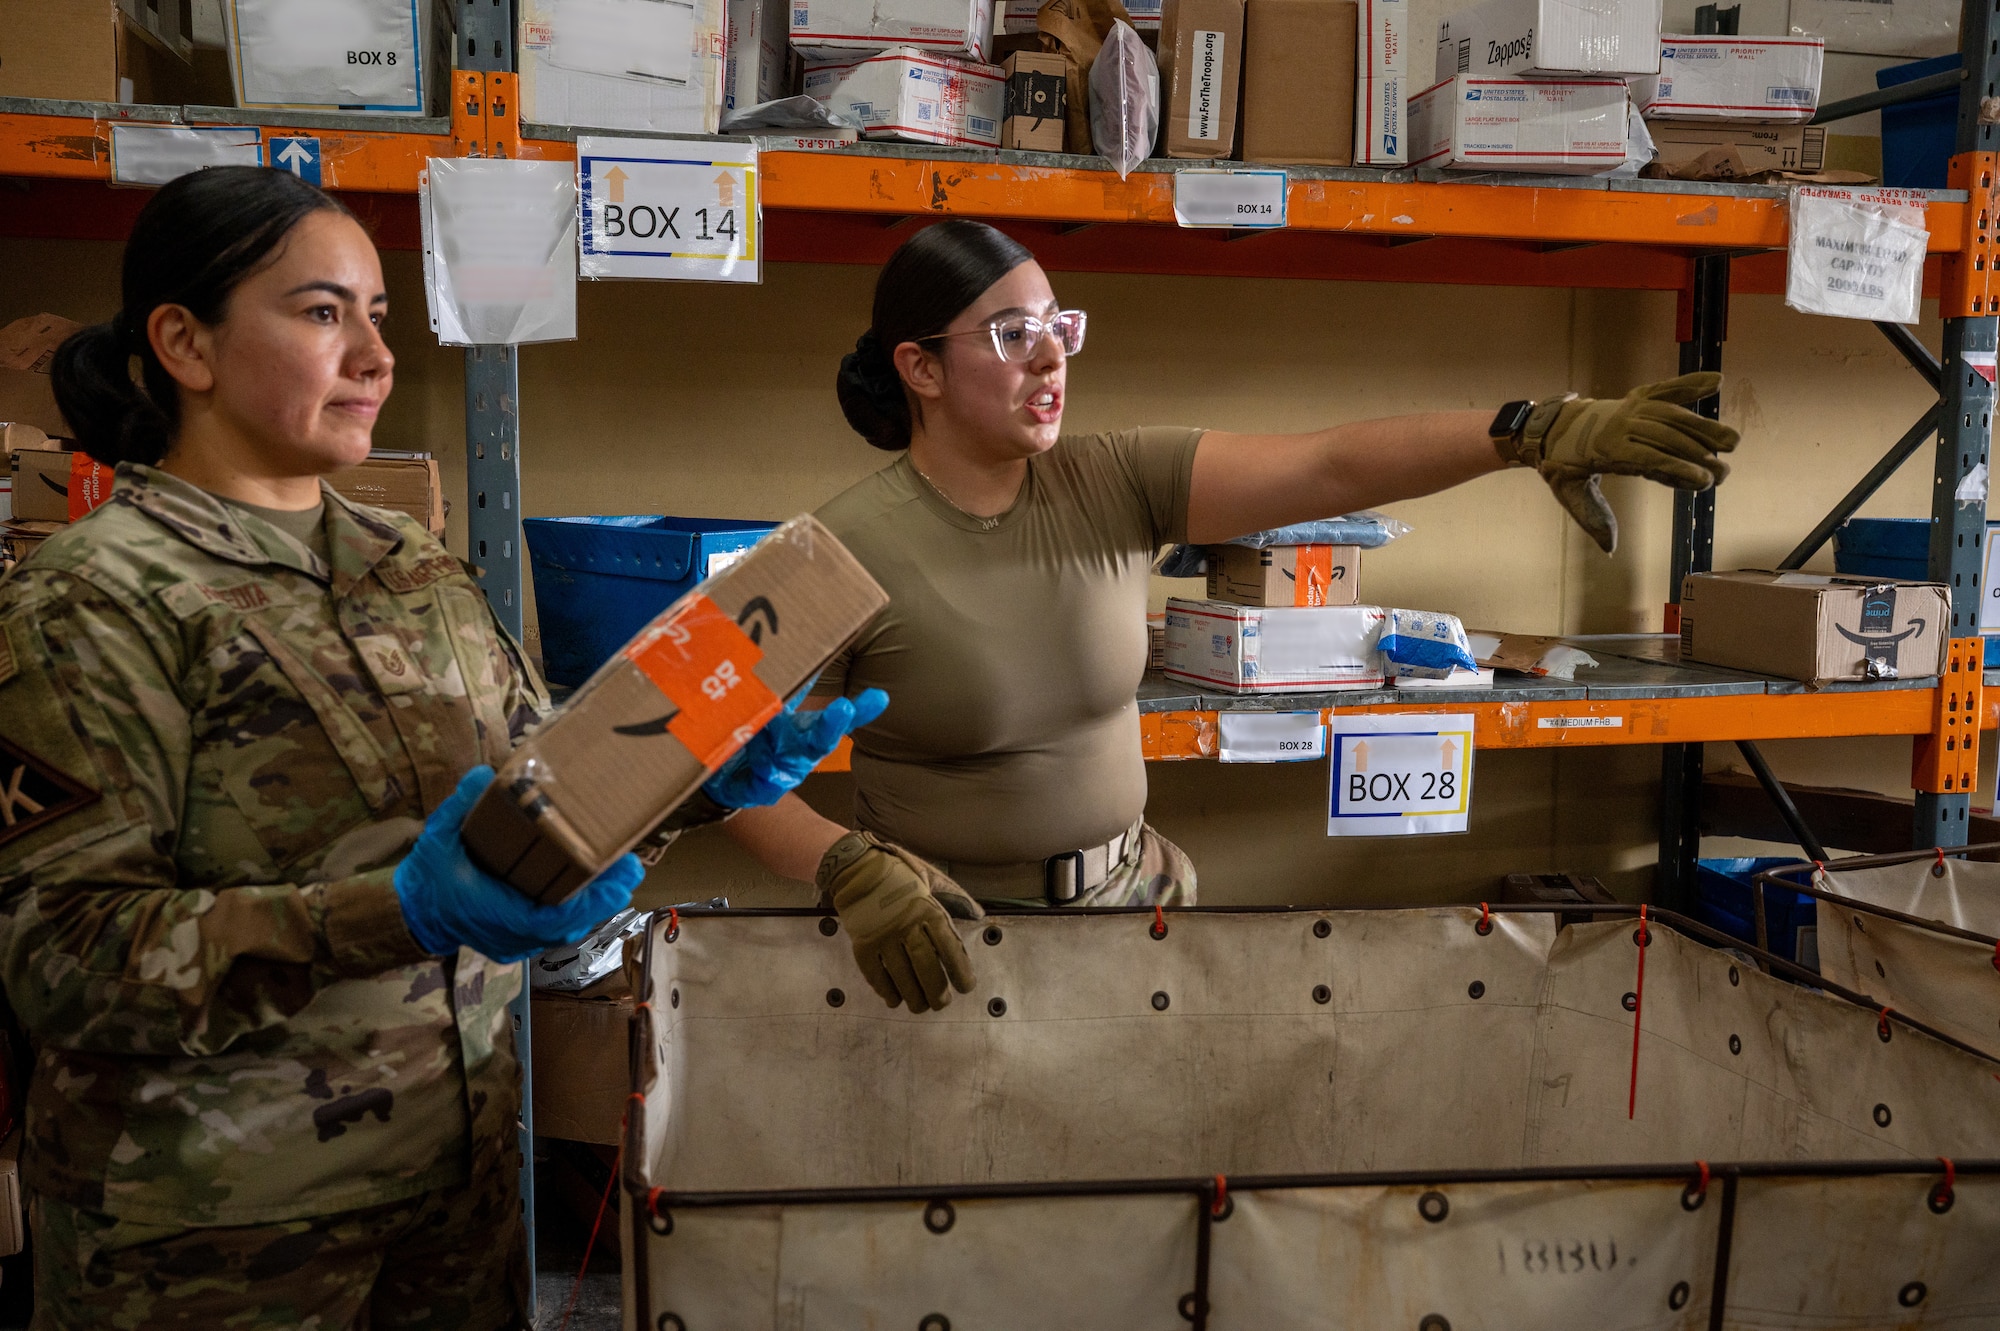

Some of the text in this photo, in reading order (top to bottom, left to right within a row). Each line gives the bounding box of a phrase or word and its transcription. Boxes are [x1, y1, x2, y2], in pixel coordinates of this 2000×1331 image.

[530, 27, 550, 35] PRIO
[1488, 37, 1526, 67] Zappos
[347, 51, 396, 65] BOX 8
[1200, 32, 1216, 138] www.ForTheTroops.org
[1752, 132, 1778, 140] From:
[794, 139, 834, 149] U.S.P.S.
[1764, 146, 1777, 154] To:
[1800, 188, 1852, 200] REWRAPPED
[1877, 189, 1926, 198] THE U.S.P.S.
[1860, 194, 1902, 206] RESEALED
[1238, 204, 1272, 214] BOX 14
[604, 204, 738, 241] BOX 14
[1866, 608, 1890, 618] prime
[1560, 719, 1592, 727] MEDIUM
[1280, 741, 1312, 750] BOX 28
[1349, 772, 1455, 802] BOX 28
